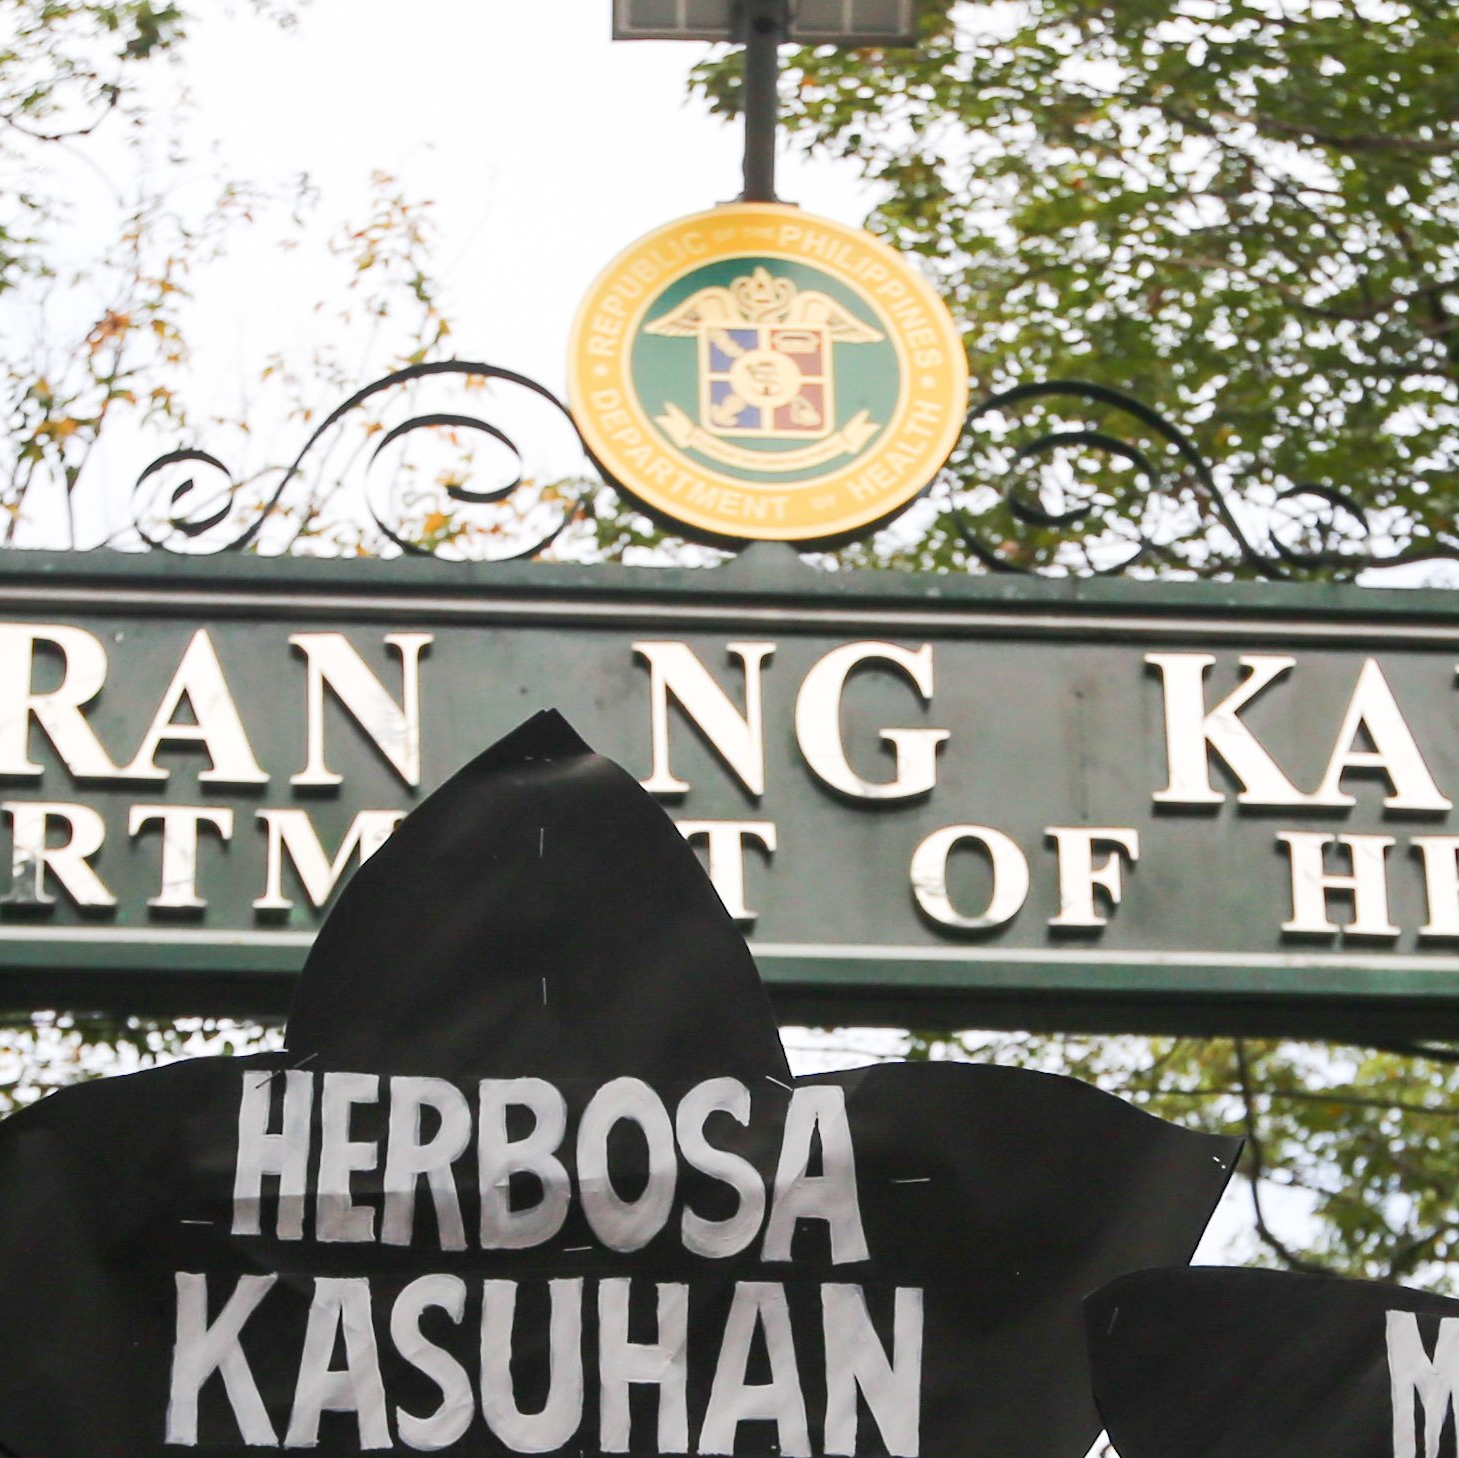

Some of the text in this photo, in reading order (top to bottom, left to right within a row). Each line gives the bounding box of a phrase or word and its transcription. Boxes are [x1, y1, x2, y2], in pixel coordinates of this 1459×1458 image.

[587, 231, 707, 357] REPUBLIC
[778, 224, 943, 378] PHILIPPINES
[592, 388, 790, 520] DEPARTMENT
[848, 400, 943, 502] HEALTH
[630, 640, 951, 800] NG
[910, 824, 1140, 929] OF
[230, 1069, 871, 1266] HERBOSA
[164, 1272, 924, 1458] KASUHAN
